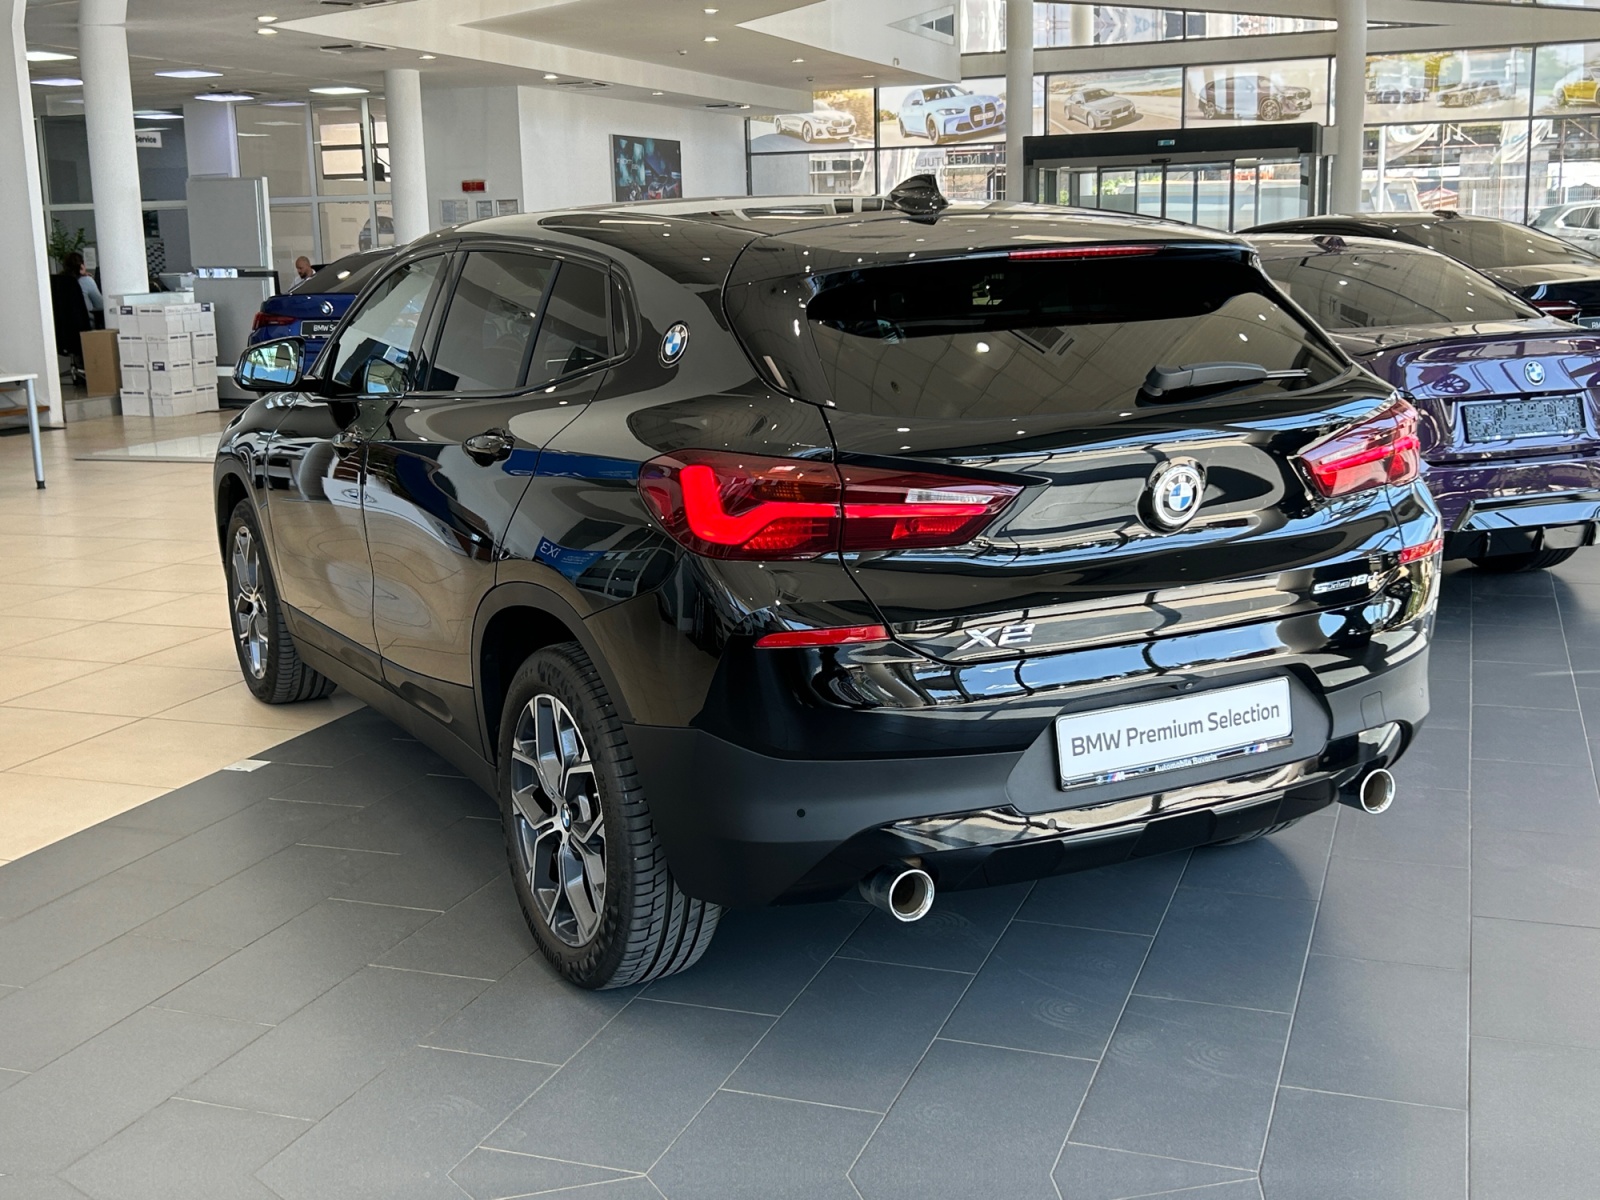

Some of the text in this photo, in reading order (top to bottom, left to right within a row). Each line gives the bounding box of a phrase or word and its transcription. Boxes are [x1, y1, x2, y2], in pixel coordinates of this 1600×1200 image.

[313, 324, 329, 332] BMW
[956, 623, 1036, 651] X2
[1071, 703, 1280, 757] BMW Premium Selection
